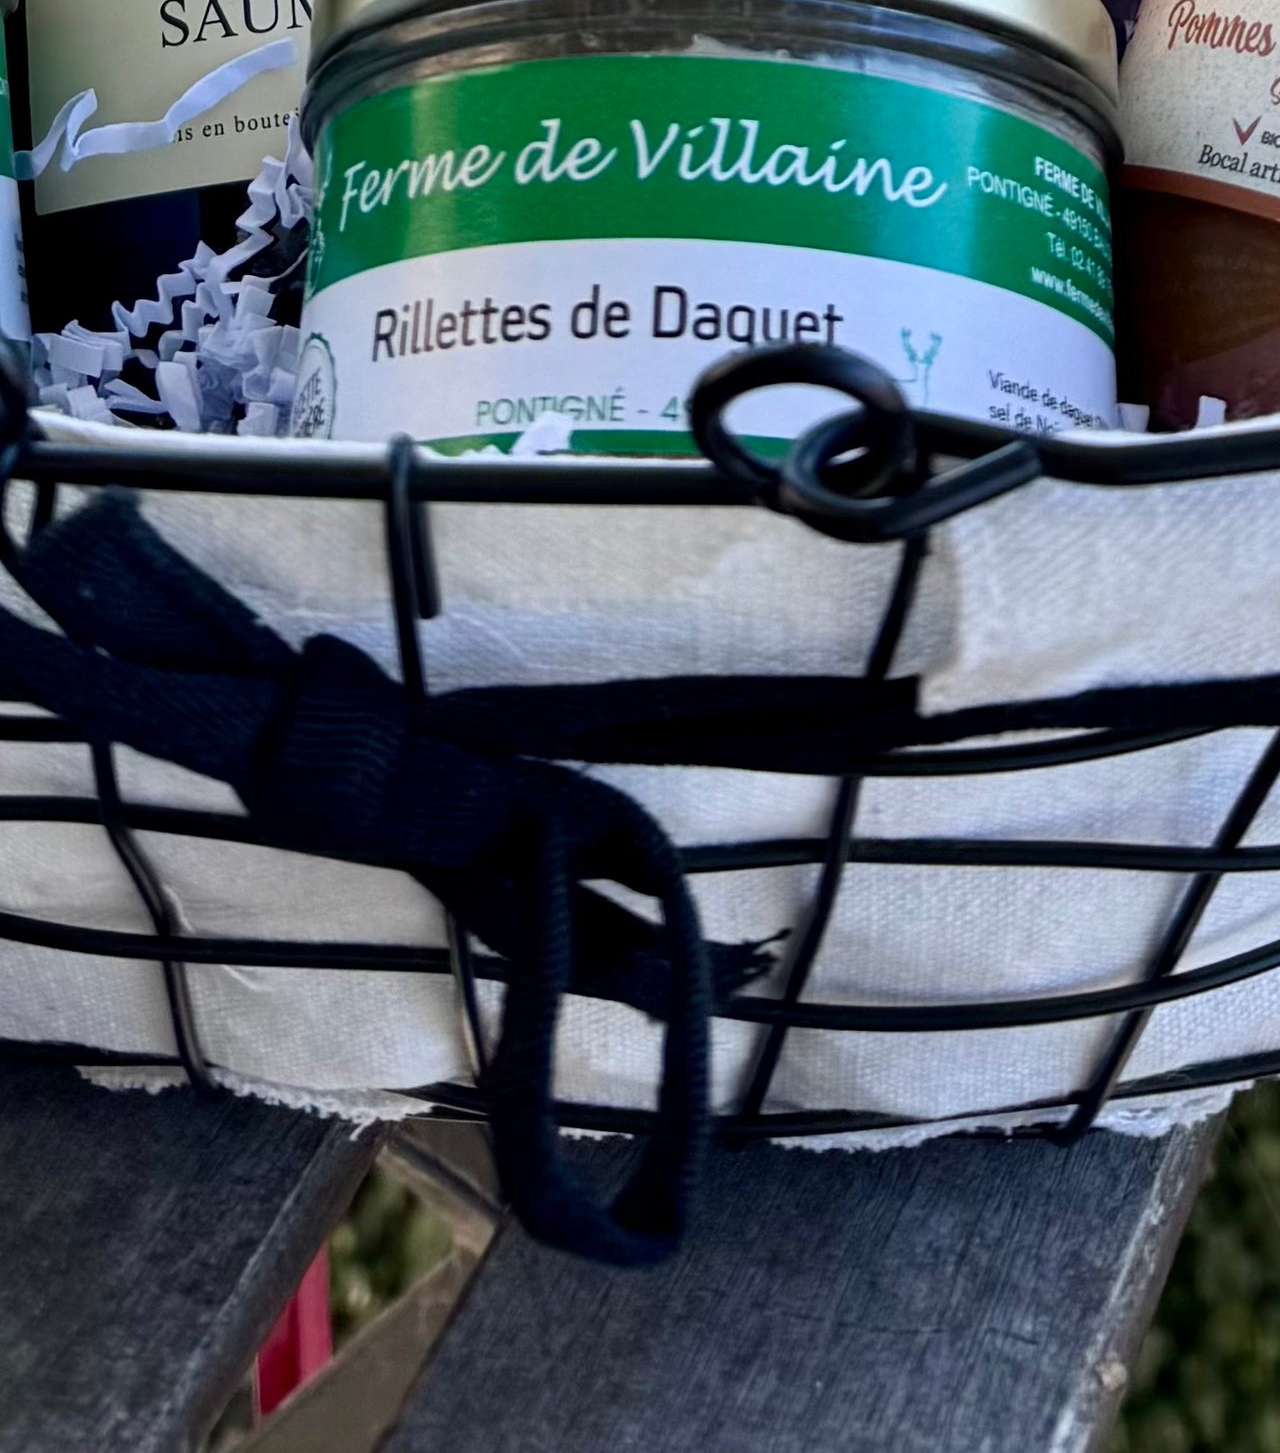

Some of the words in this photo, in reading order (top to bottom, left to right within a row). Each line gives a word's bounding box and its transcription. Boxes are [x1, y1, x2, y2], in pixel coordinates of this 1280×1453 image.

[202, 120, 226, 138] en
[338, 143, 507, 233] Ferme
[514, 117, 618, 185] de
[629, 116, 948, 208] Villaine
[1034, 155, 1080, 198] FERME
[1198, 144, 1249, 175] Bocal
[967, 165, 1054, 218] PONTIGNÉ
[371, 295, 552, 363] Rillettes
[570, 283, 631, 340] de
[653, 285, 844, 347] Daguet
[988, 369, 1039, 402] Viande
[1042, 388, 1058, 410] de
[989, 403, 1011, 422] sel
